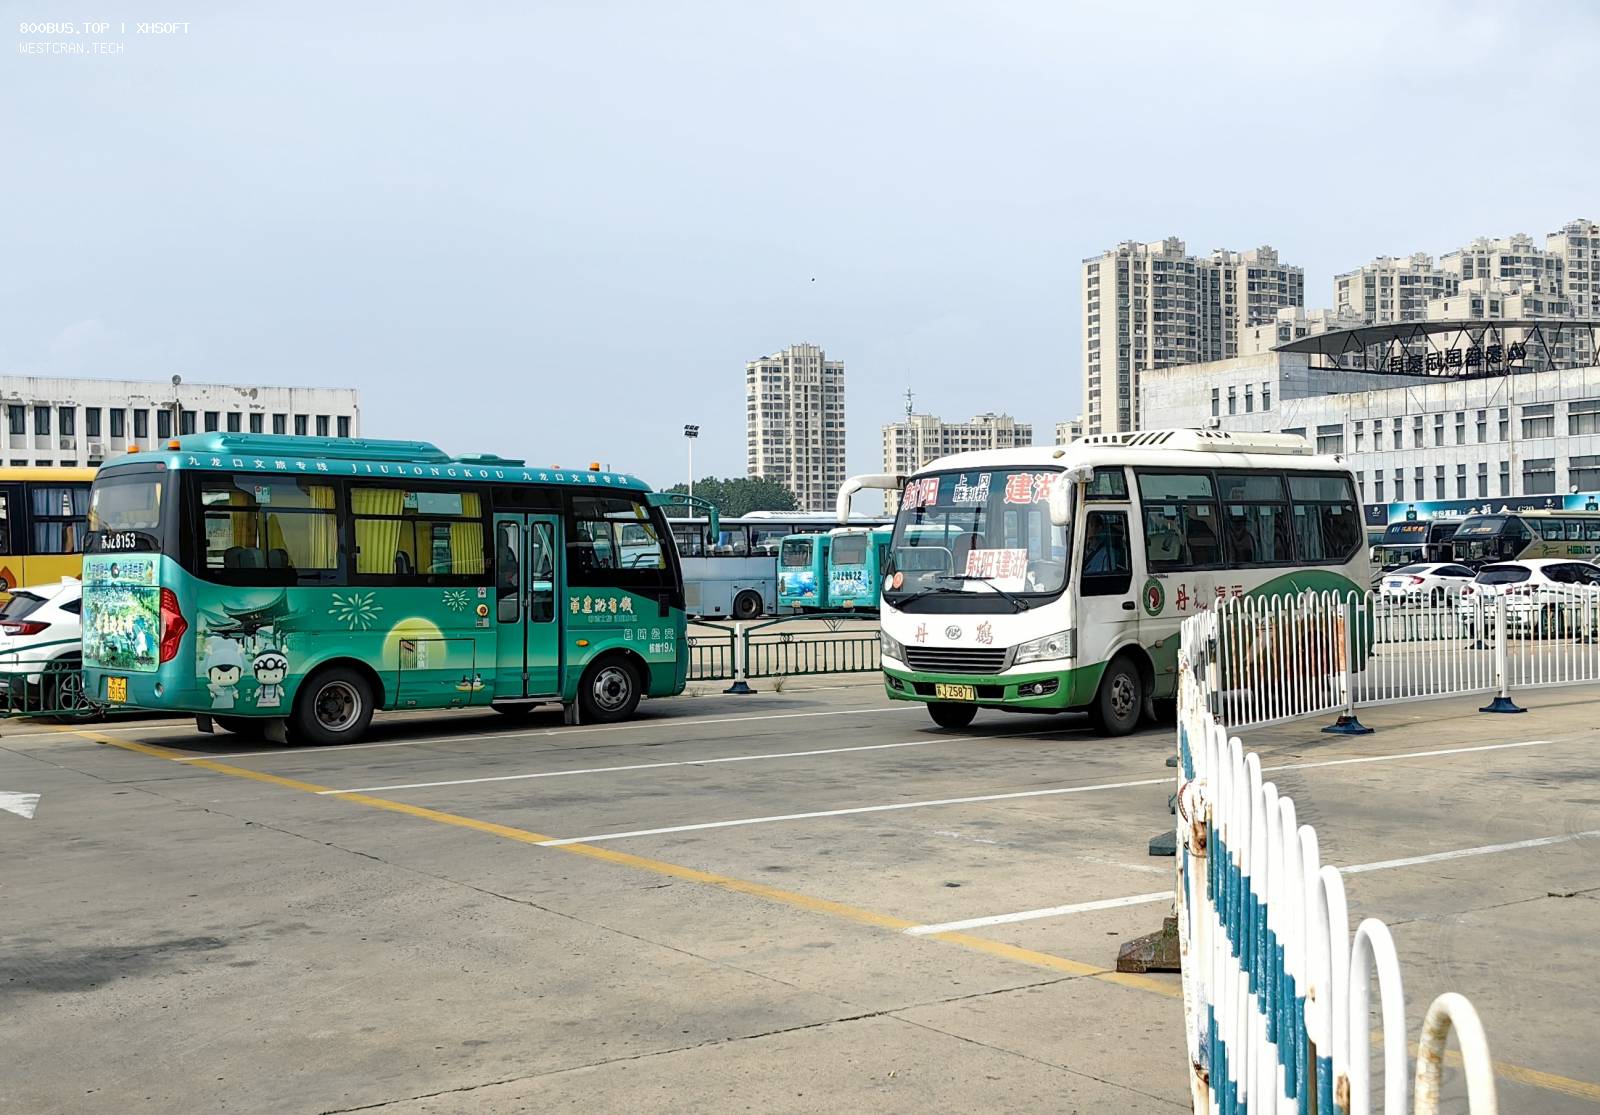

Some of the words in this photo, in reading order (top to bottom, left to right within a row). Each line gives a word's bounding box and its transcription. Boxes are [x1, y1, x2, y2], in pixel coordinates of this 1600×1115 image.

[188, 455, 329, 471] 九龙口文旅专线
[351, 463, 505, 478] JIULONGKOU
[901, 478, 940, 511] 射阳
[952, 484, 988, 502] 胜利桥
[915, 622, 928, 643] 丹
